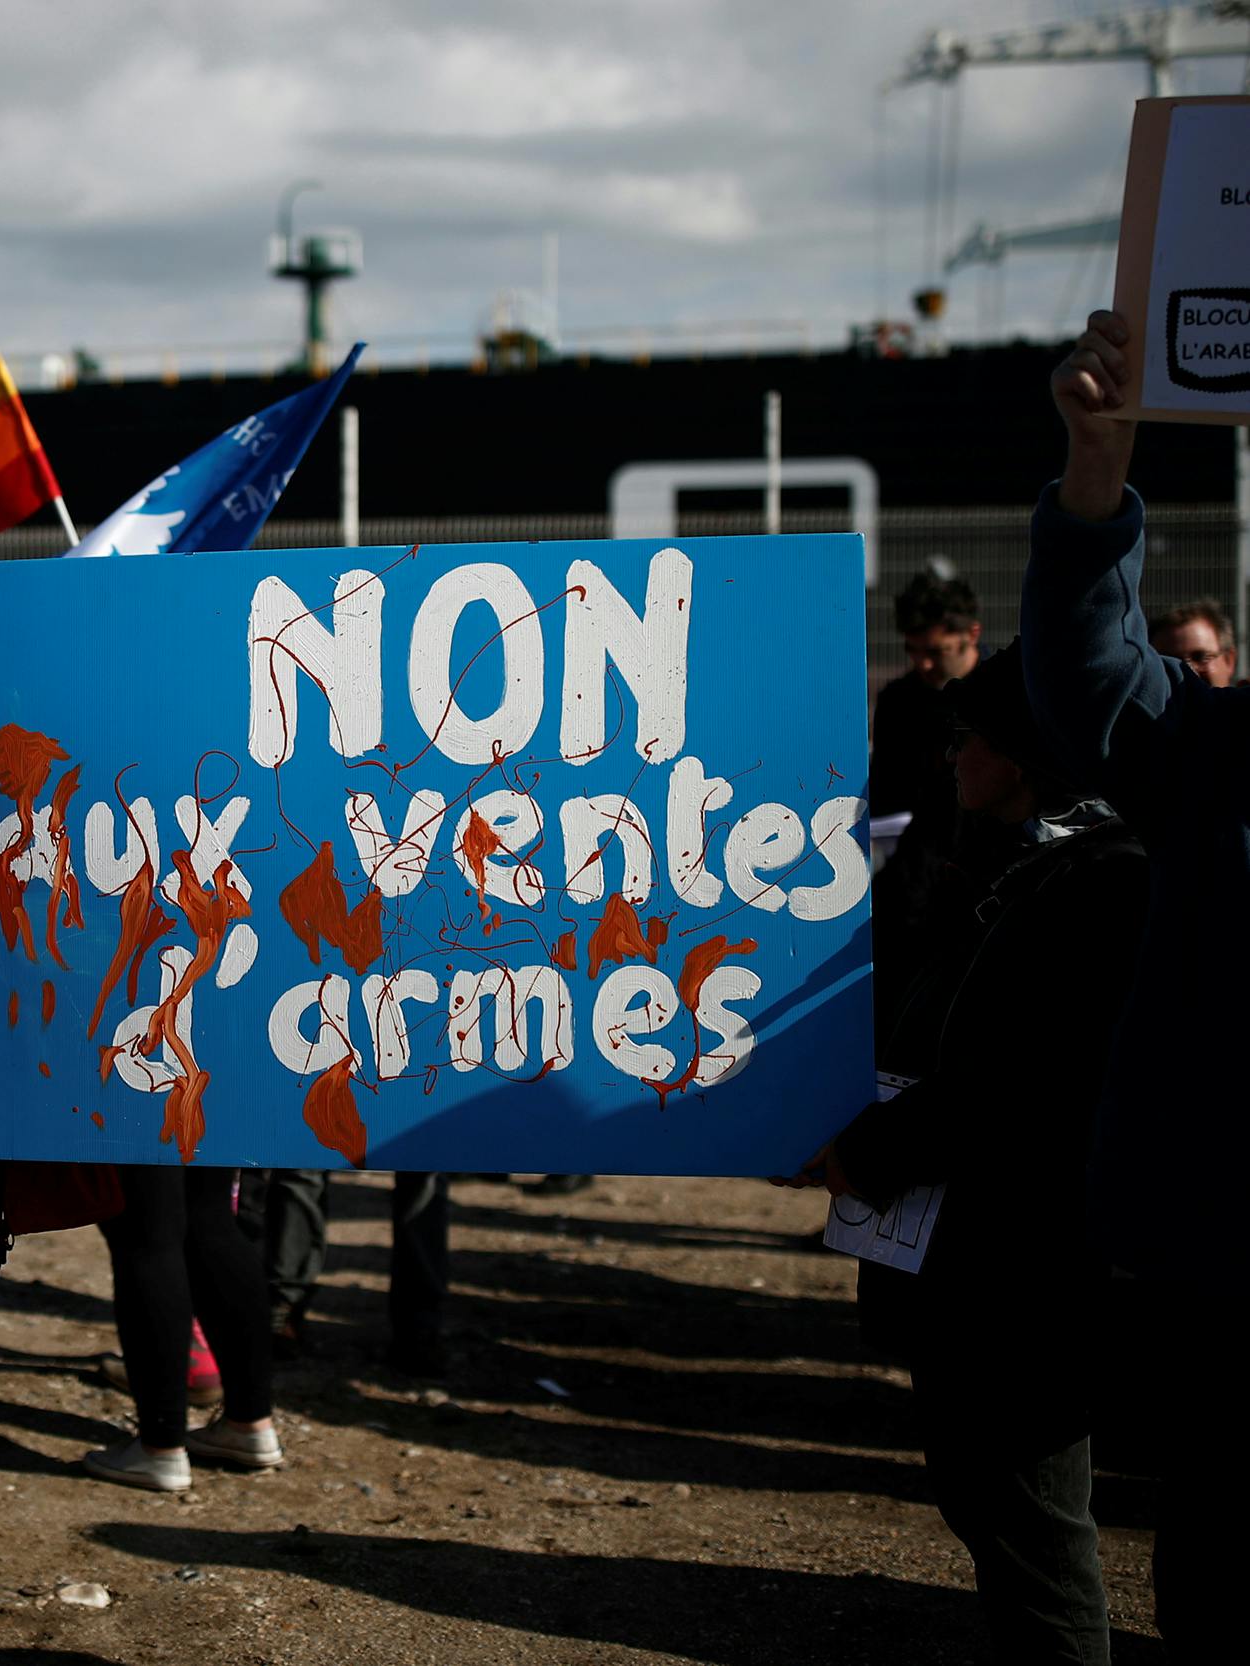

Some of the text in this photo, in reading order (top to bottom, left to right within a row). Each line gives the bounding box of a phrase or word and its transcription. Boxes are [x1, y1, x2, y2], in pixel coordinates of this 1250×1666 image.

[248, 548, 693, 768] NON
[345, 756, 870, 921] ventes
[111, 923, 762, 1092] d'armes
